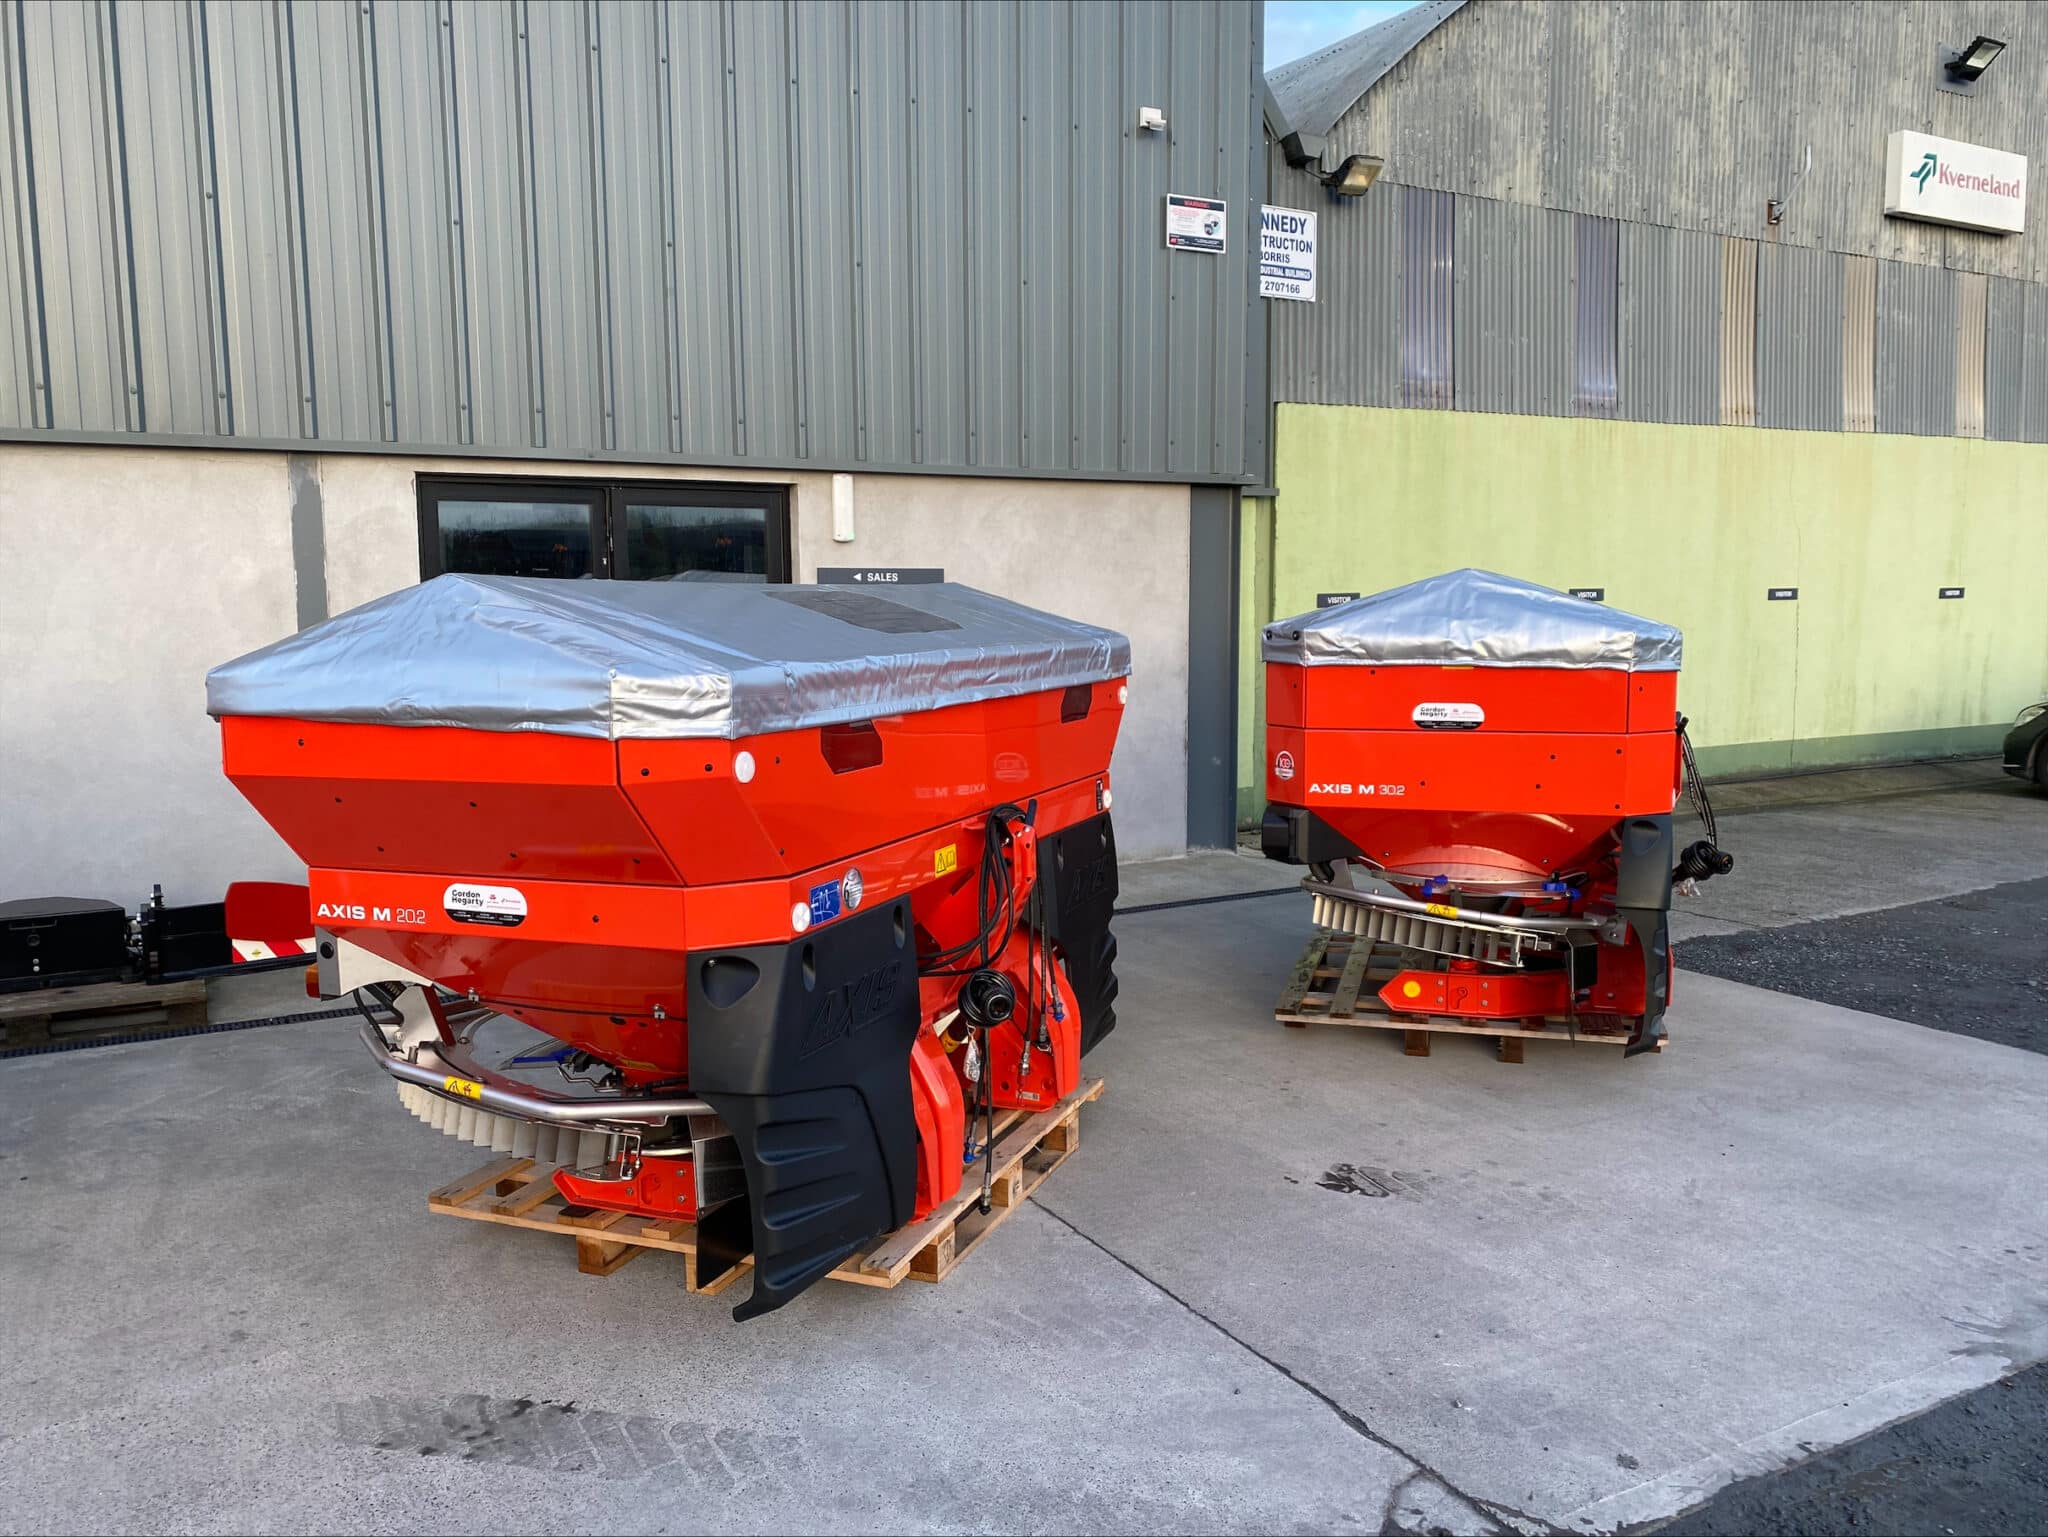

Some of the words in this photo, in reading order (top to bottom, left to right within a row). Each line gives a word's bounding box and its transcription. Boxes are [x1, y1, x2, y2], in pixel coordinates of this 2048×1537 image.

[1939, 162, 2020, 199] Kverneland
[1264, 281, 1301, 294] 2707166
[867, 572, 899, 582] SALES
[1309, 783, 1352, 795] AXIS
[1358, 784, 1375, 795] M
[451, 896, 484, 907] Hegarty
[317, 903, 366, 920] AXIS
[372, 906, 391, 922] M
